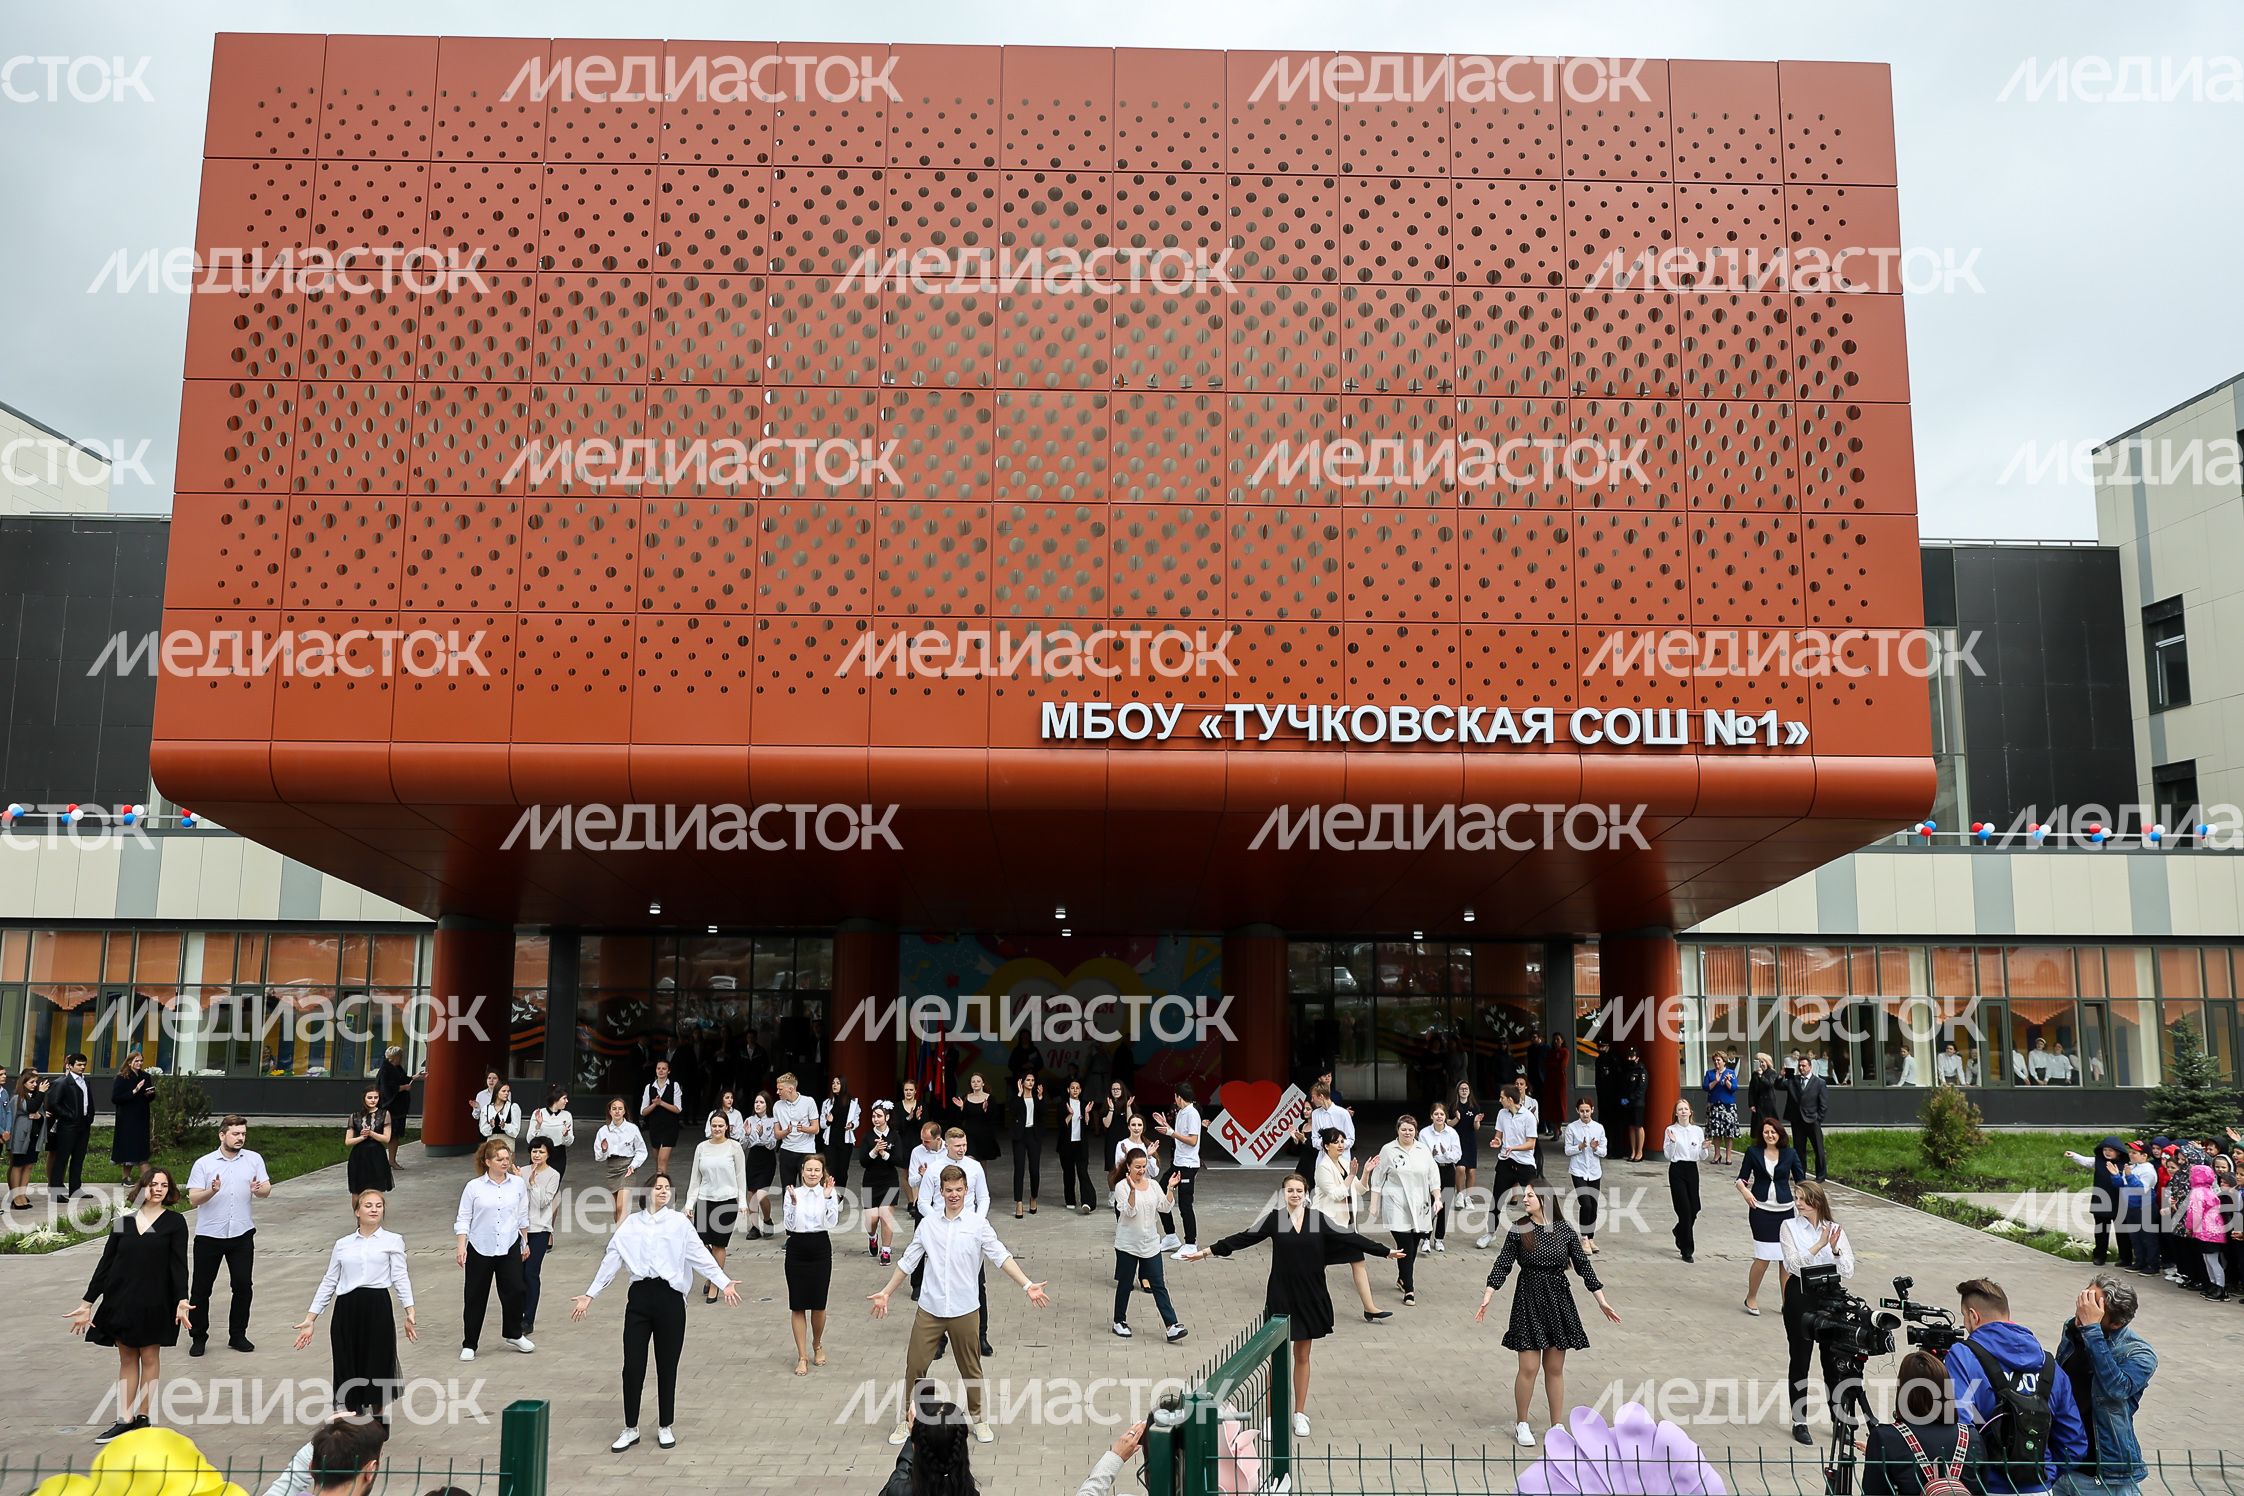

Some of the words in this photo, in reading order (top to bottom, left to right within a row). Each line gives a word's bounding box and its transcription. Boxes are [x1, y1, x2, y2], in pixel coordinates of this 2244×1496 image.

[1041, 701, 1185, 740] МБОУ
[1200, 703, 1555, 744] «ТУЧКОВСКАЯ
[1570, 706, 1690, 747] СОШ
[1703, 708, 1810, 747] №1»
[1221, 1118, 1248, 1154] Я
